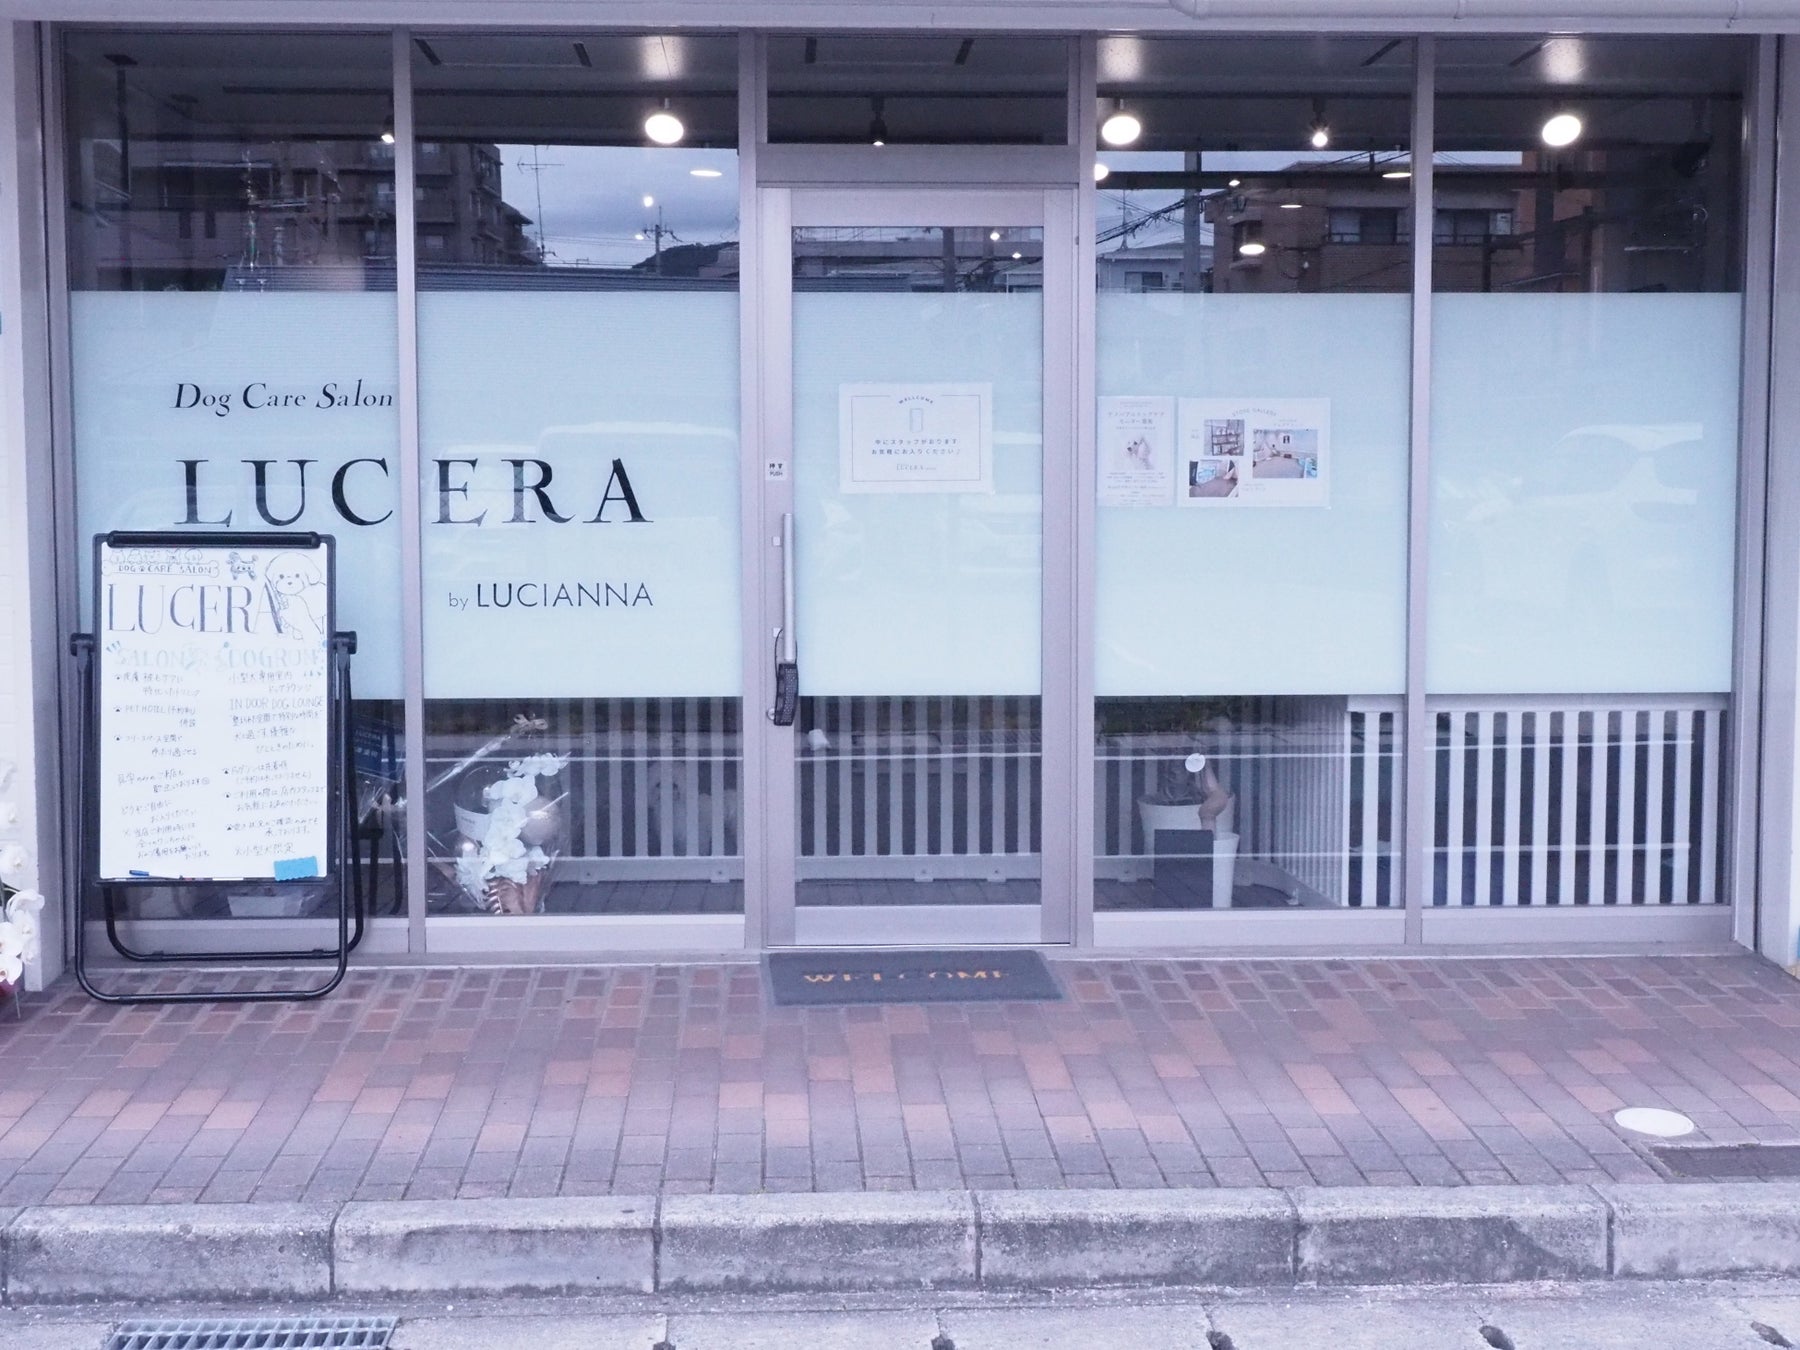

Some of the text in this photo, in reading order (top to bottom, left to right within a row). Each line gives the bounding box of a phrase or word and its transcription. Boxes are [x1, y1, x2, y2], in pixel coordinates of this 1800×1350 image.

[171, 379, 393, 417] Dog Care Salon
[174, 457, 655, 526] LUCERA
[106, 583, 283, 634] LUCERA
[448, 582, 653, 611] by LUCIANNA
